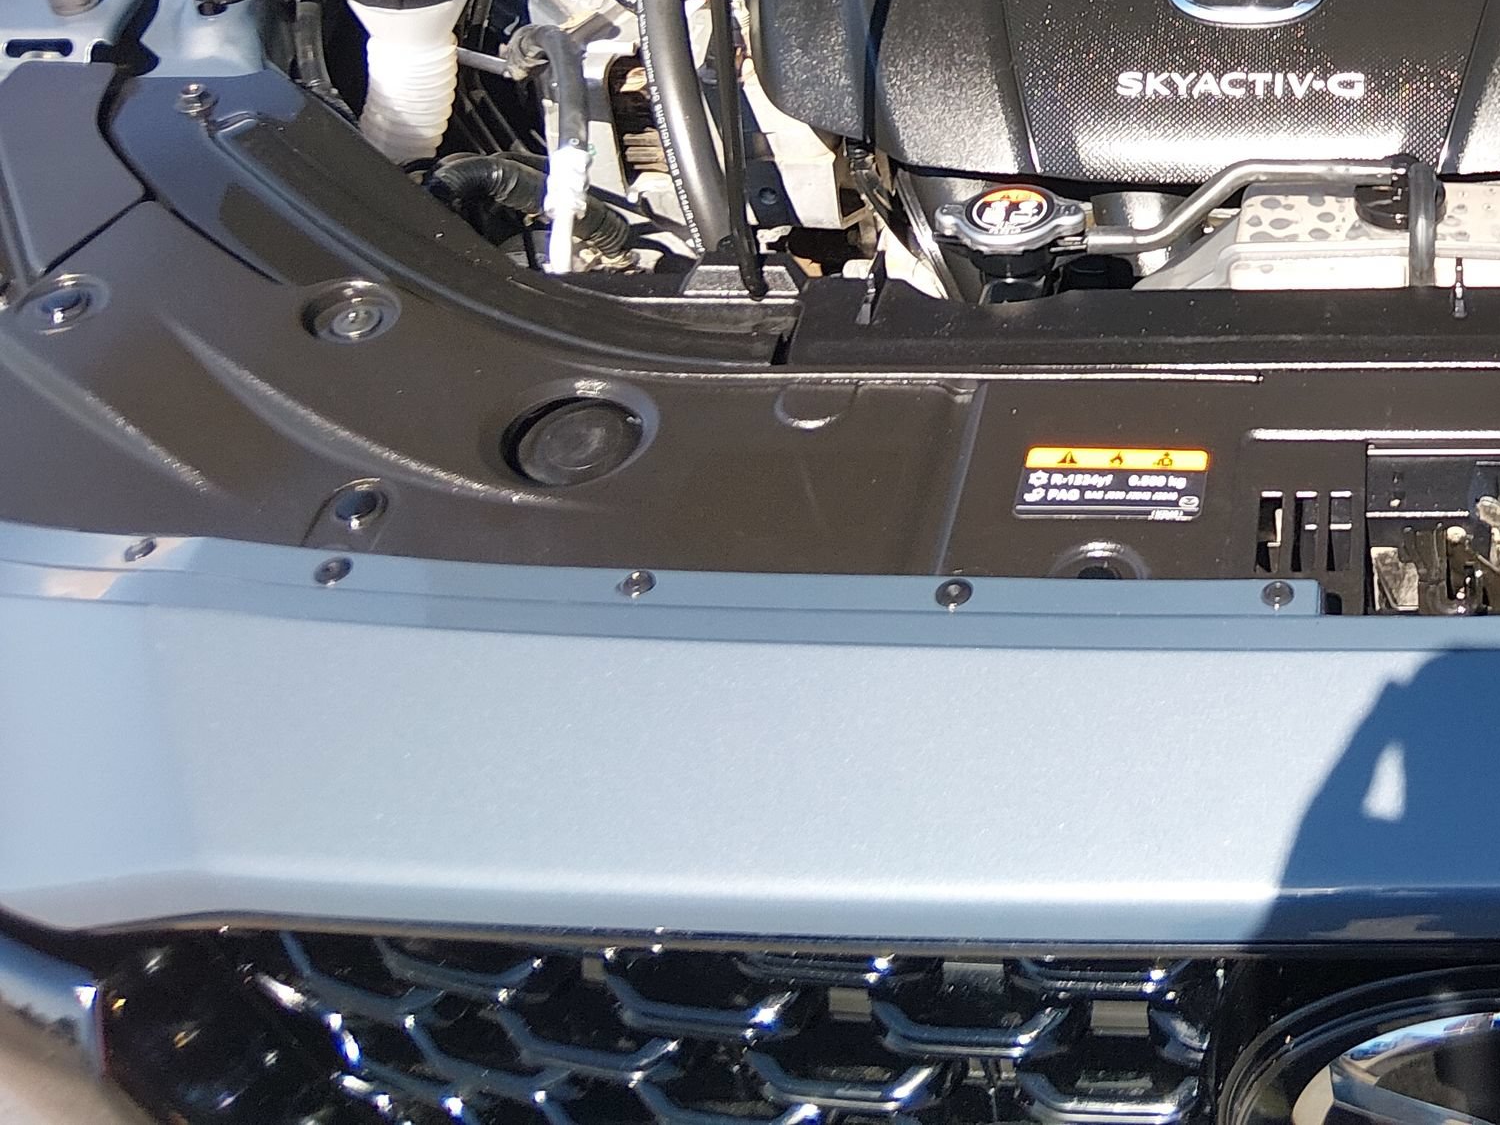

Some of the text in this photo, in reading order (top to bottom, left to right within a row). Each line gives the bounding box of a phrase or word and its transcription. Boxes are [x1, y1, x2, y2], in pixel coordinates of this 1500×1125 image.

[1116, 70, 1366, 100] SKYACTIV-G
[654, 104, 671, 147] SUCTION
[666, 148, 680, 177] HOSE
